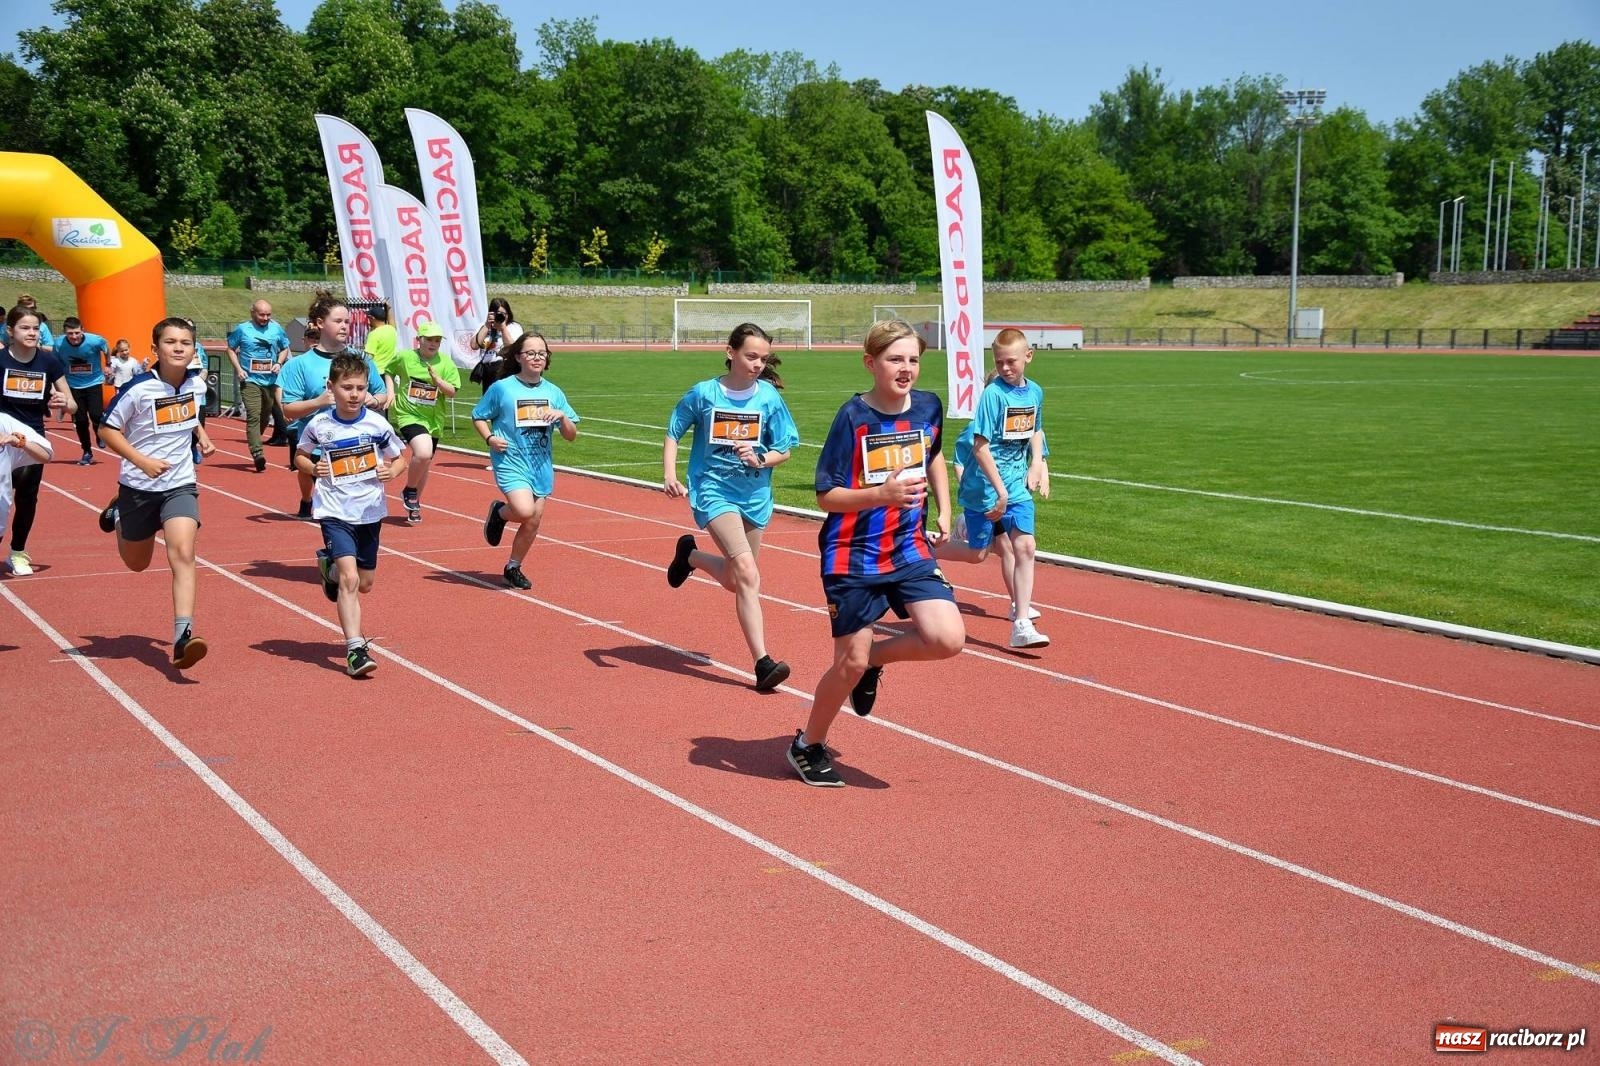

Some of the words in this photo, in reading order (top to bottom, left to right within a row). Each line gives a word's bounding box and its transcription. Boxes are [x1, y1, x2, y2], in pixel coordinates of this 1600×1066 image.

[16, 380, 36, 391] 104
[169, 405, 189, 421] 110
[725, 423, 749, 437] 145
[343, 456, 367, 473] 114
[883, 447, 912, 467] 118
